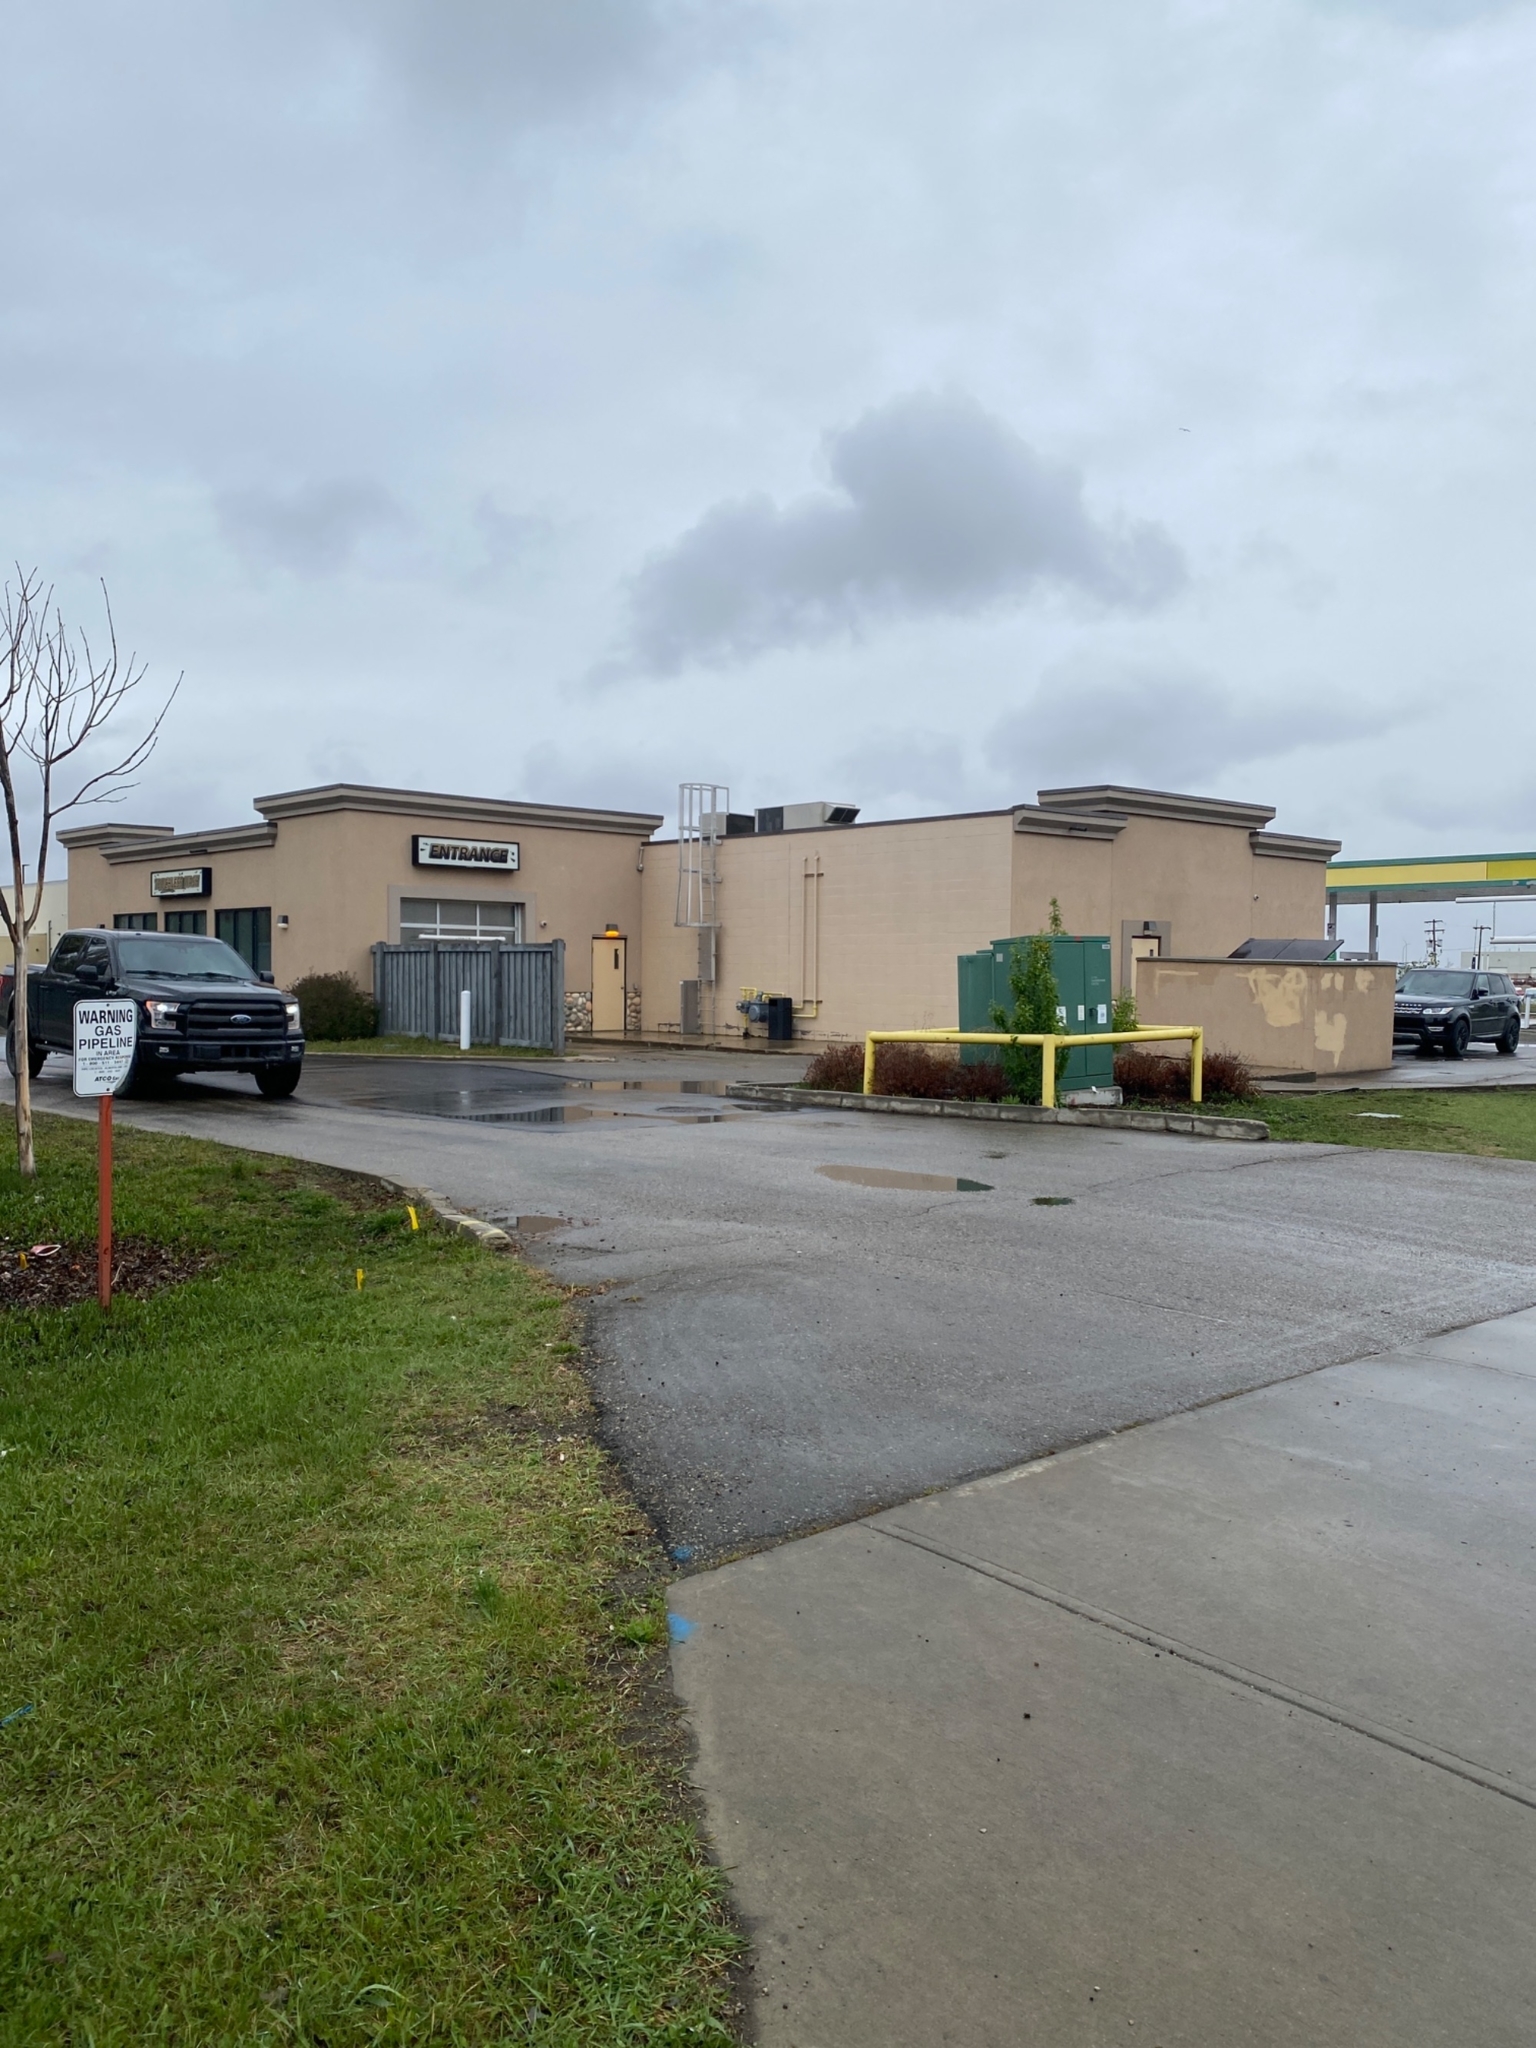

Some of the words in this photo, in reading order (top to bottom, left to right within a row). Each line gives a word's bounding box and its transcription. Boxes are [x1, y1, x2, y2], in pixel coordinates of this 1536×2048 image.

[429, 843, 509, 863] ENTRANCE
[79, 1009, 133, 1024] WARNING
[95, 1025, 121, 1036] GAS
[79, 1037, 133, 1050] PIPELINE
